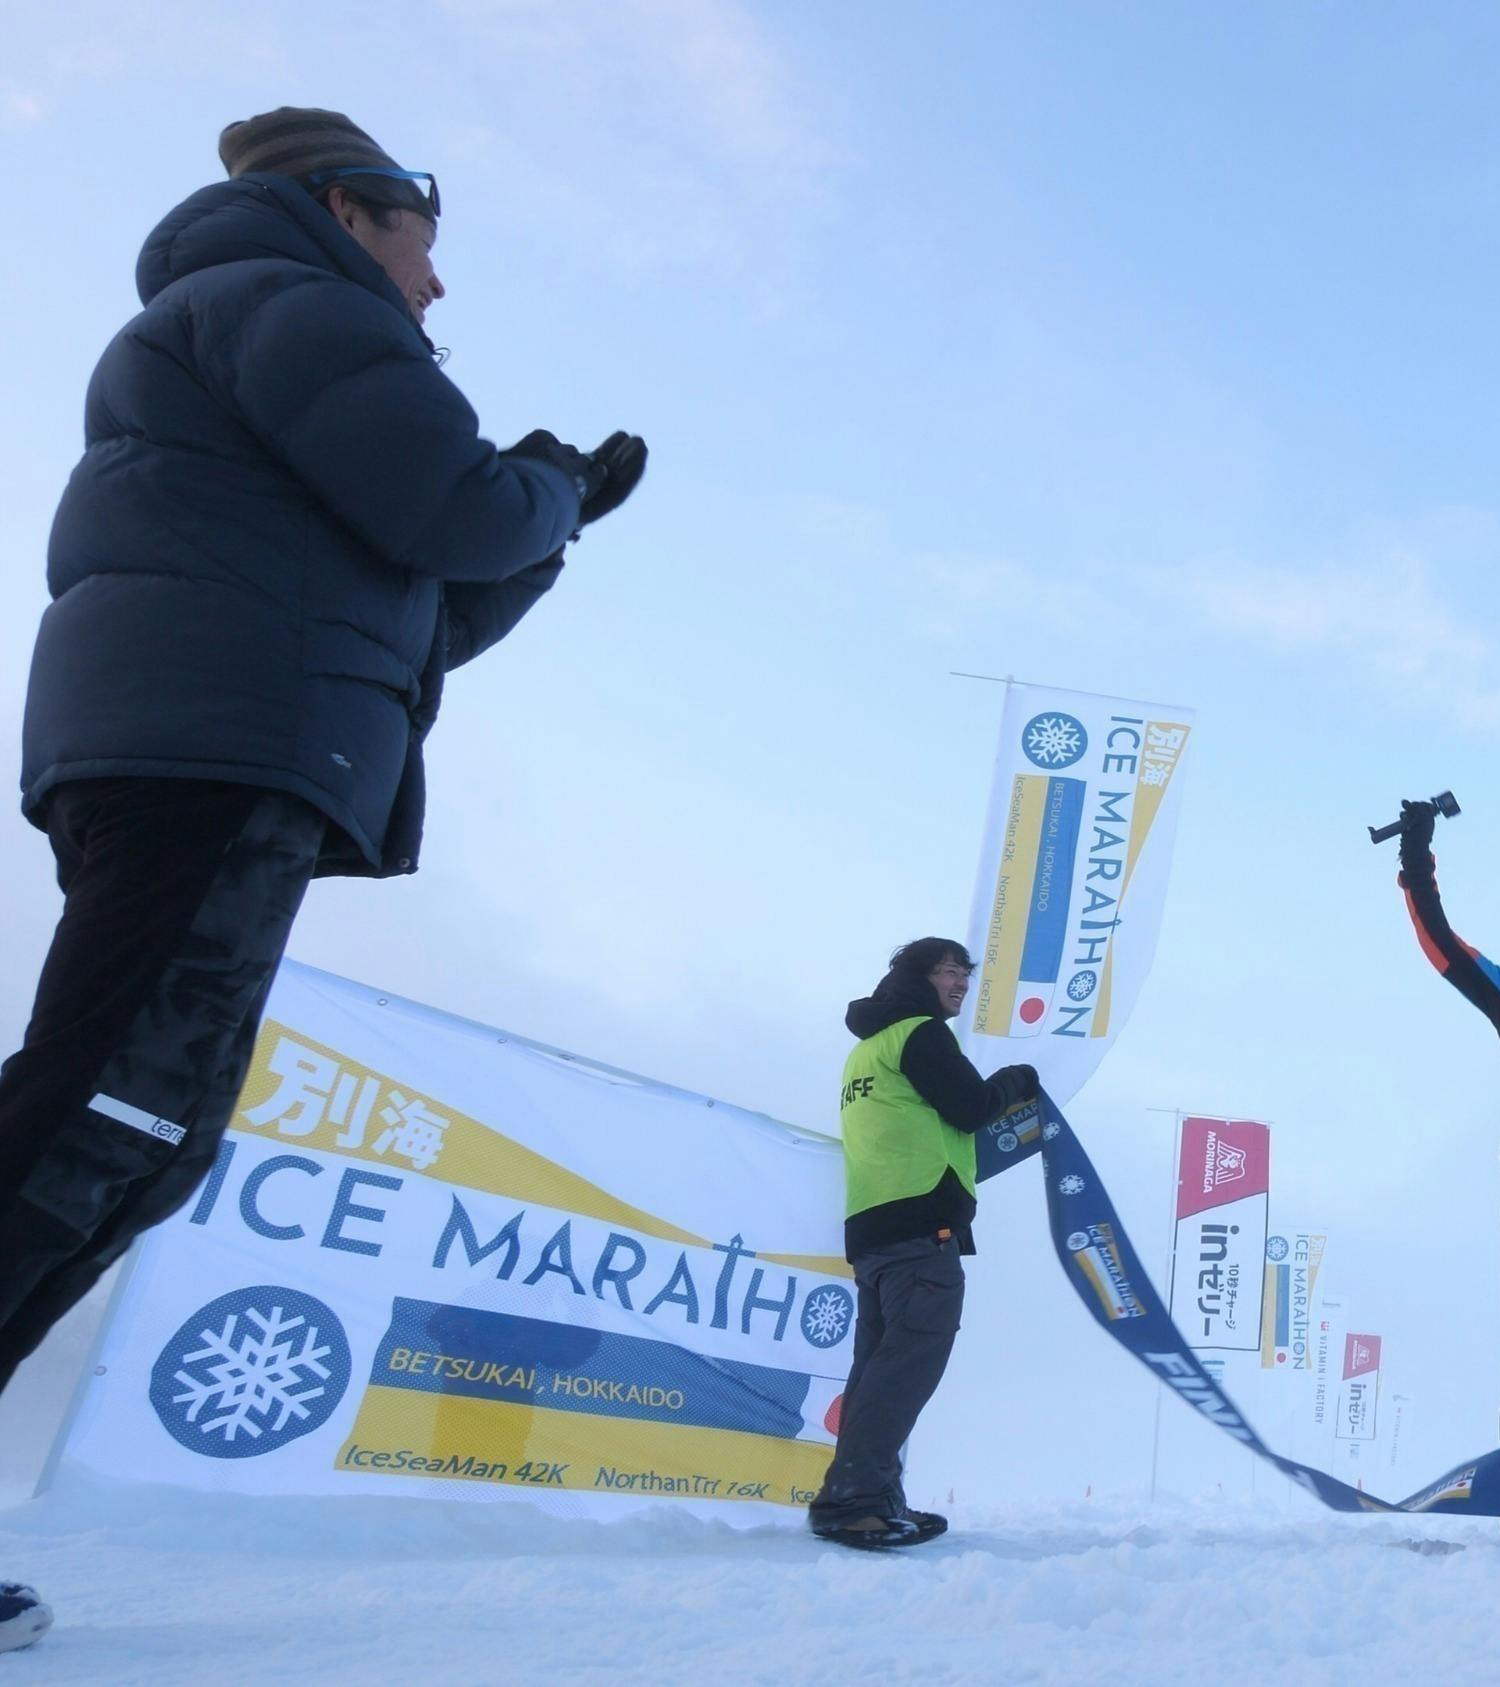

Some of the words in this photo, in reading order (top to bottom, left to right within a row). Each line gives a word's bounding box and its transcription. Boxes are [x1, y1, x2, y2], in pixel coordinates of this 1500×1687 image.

[1102, 716, 1143, 774] ICE
[1140, 724, 1186, 786] 別海
[1003, 839, 1015, 862] 42K
[1037, 846, 1055, 912] HOKKAIDO
[1050, 790, 1131, 1038] MARATHON
[986, 943, 998, 966] 16K
[976, 1014, 988, 1032] 2K
[980, 978, 992, 1012] IceTri
[242, 1037, 450, 1170] 別海
[1203, 1130, 1216, 1193] MORINAGA
[189, 1139, 404, 1257] ICE
[1295, 1234, 1309, 1261] ICE
[1293, 1267, 1309, 1370] MARATHON
[552, 1374, 685, 1410] HOKKAIDO
[344, 1445, 508, 1480] IceSeaMan
[513, 1461, 572, 1484] 42K
[593, 1466, 720, 1495] NorthanTri
[726, 1481, 770, 1500] 16K
[791, 1485, 816, 1504] Ice
